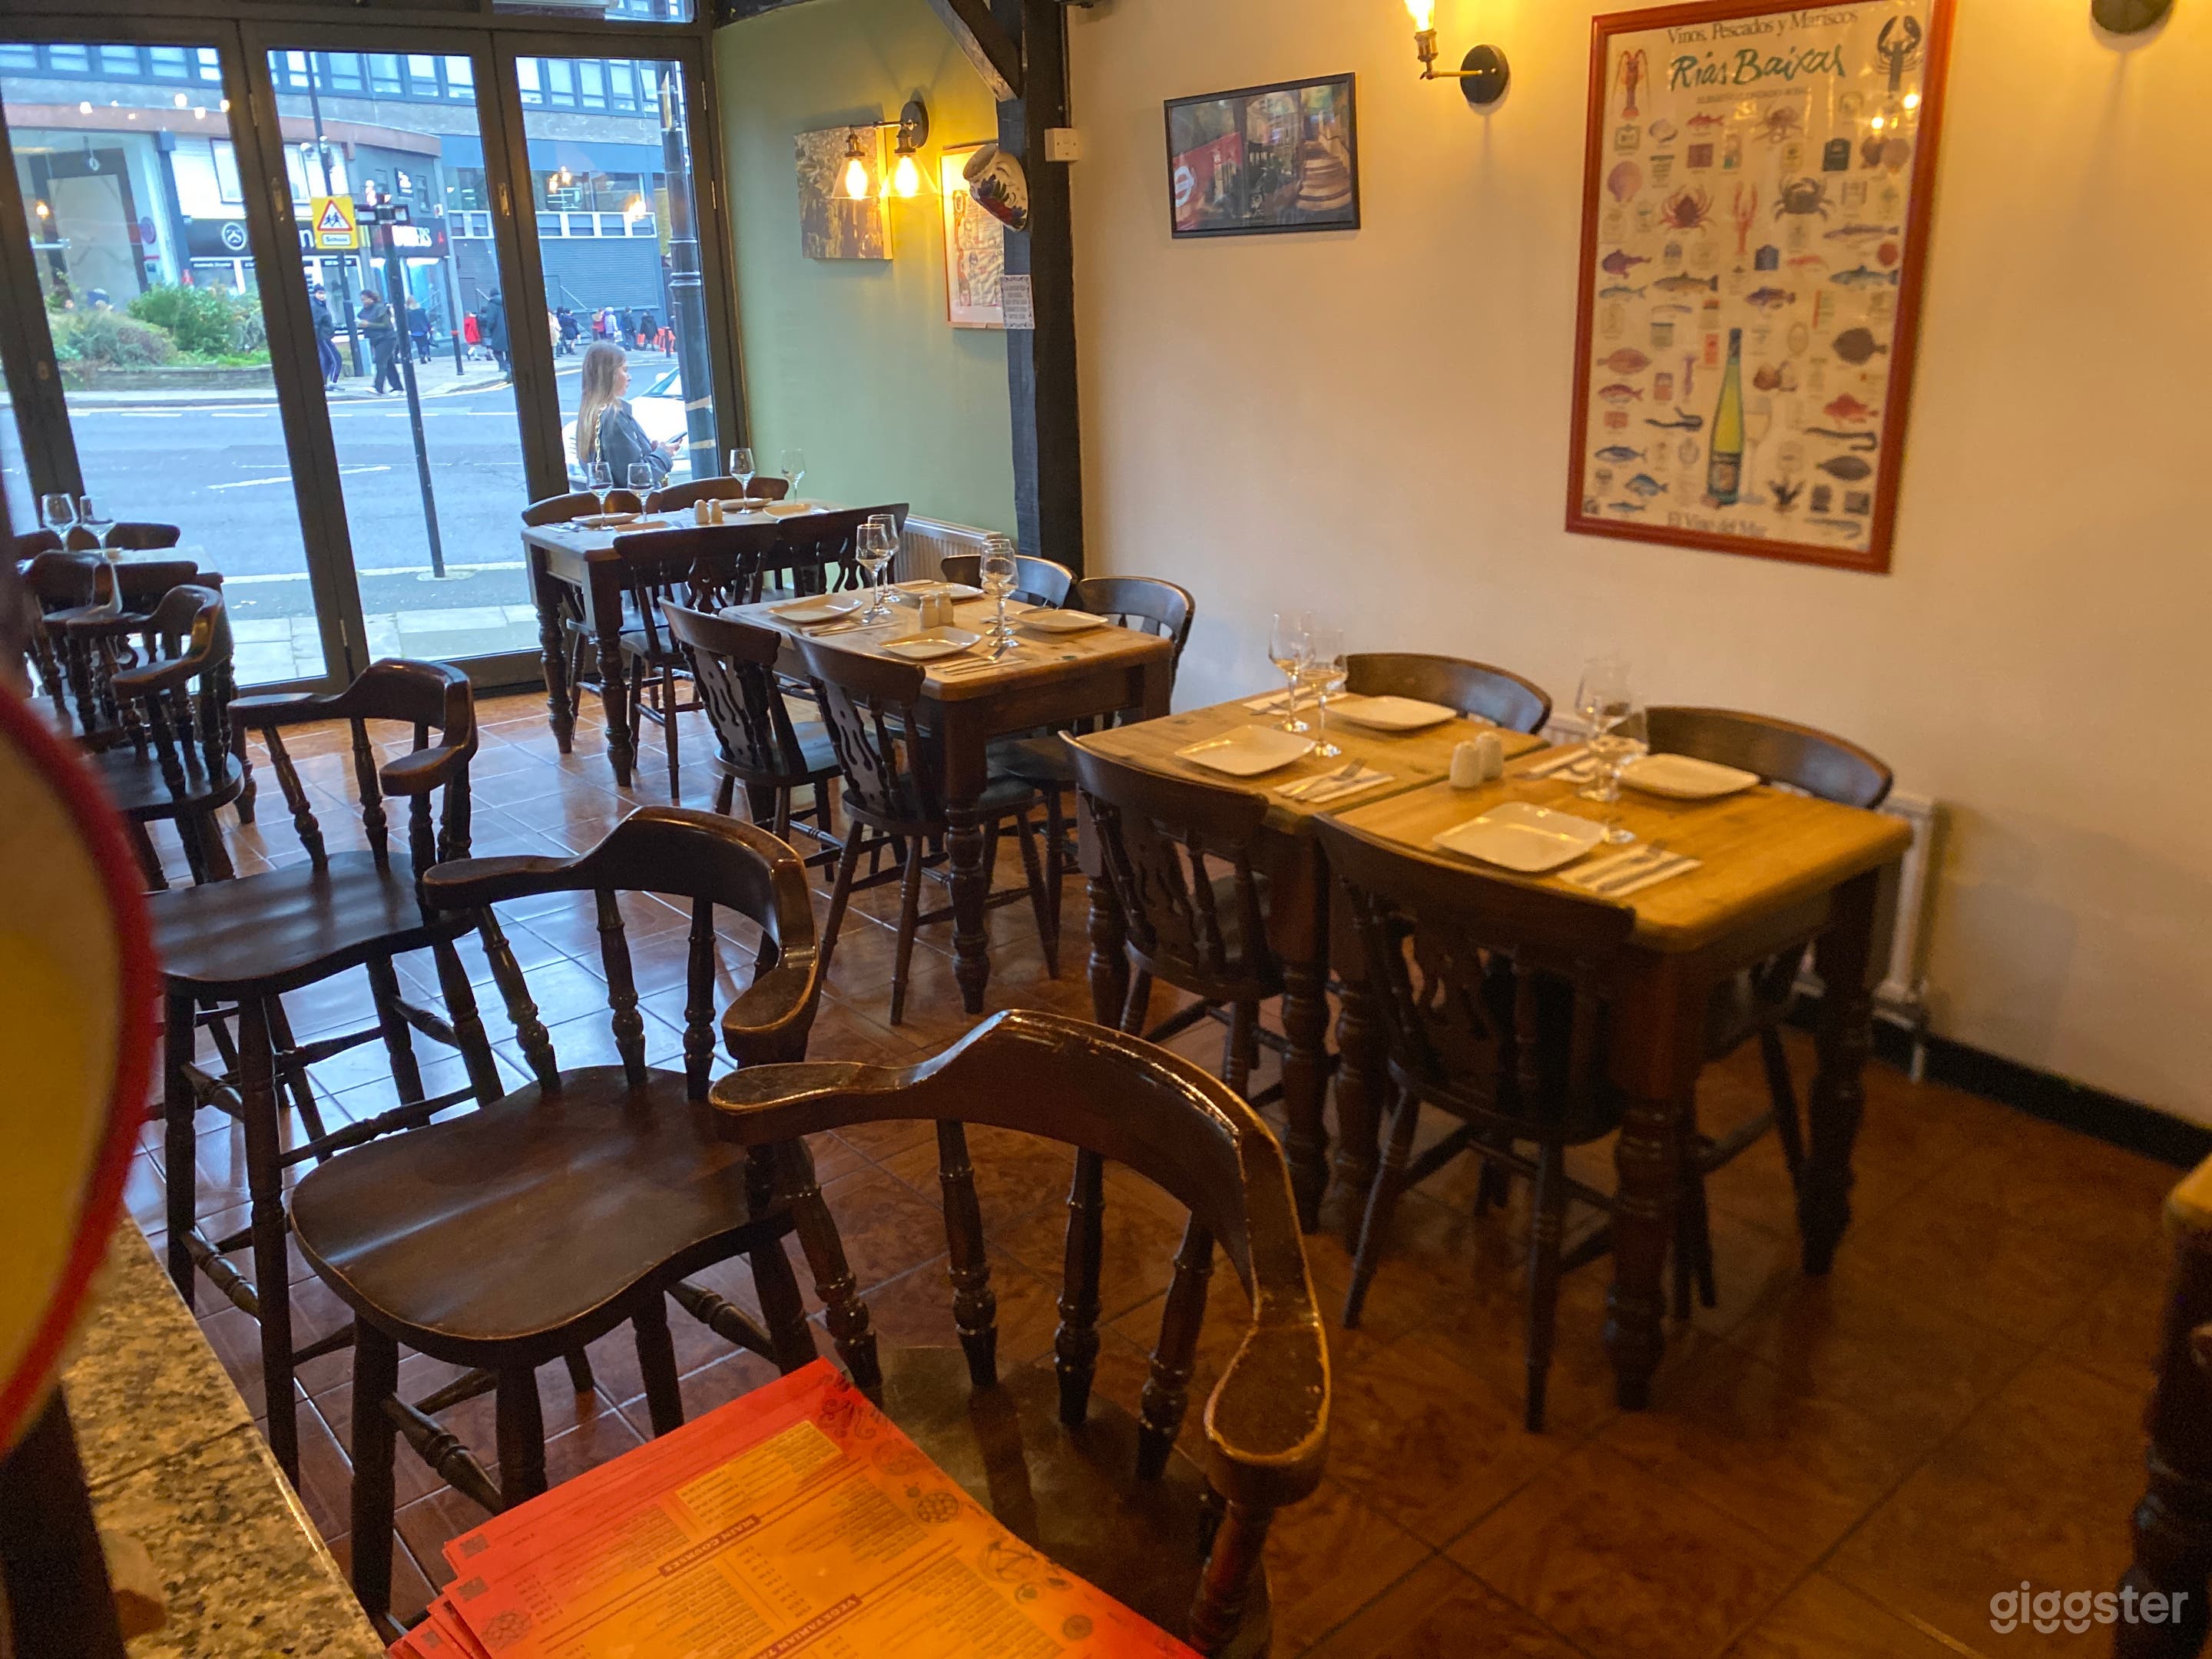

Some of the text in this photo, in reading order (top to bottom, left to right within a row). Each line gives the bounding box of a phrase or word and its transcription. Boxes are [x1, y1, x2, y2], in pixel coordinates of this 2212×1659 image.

[1712, 18, 1773, 39] Pescados
[1776, 18, 1786, 37] y
[1790, 8, 1858, 30] Mariscos
[1733, 44, 1846, 85] Baixas
[721, 1518, 755, 1541] MAIN
[664, 1538, 720, 1571] COURSES
[777, 1599, 856, 1651] VEGETARIAN
